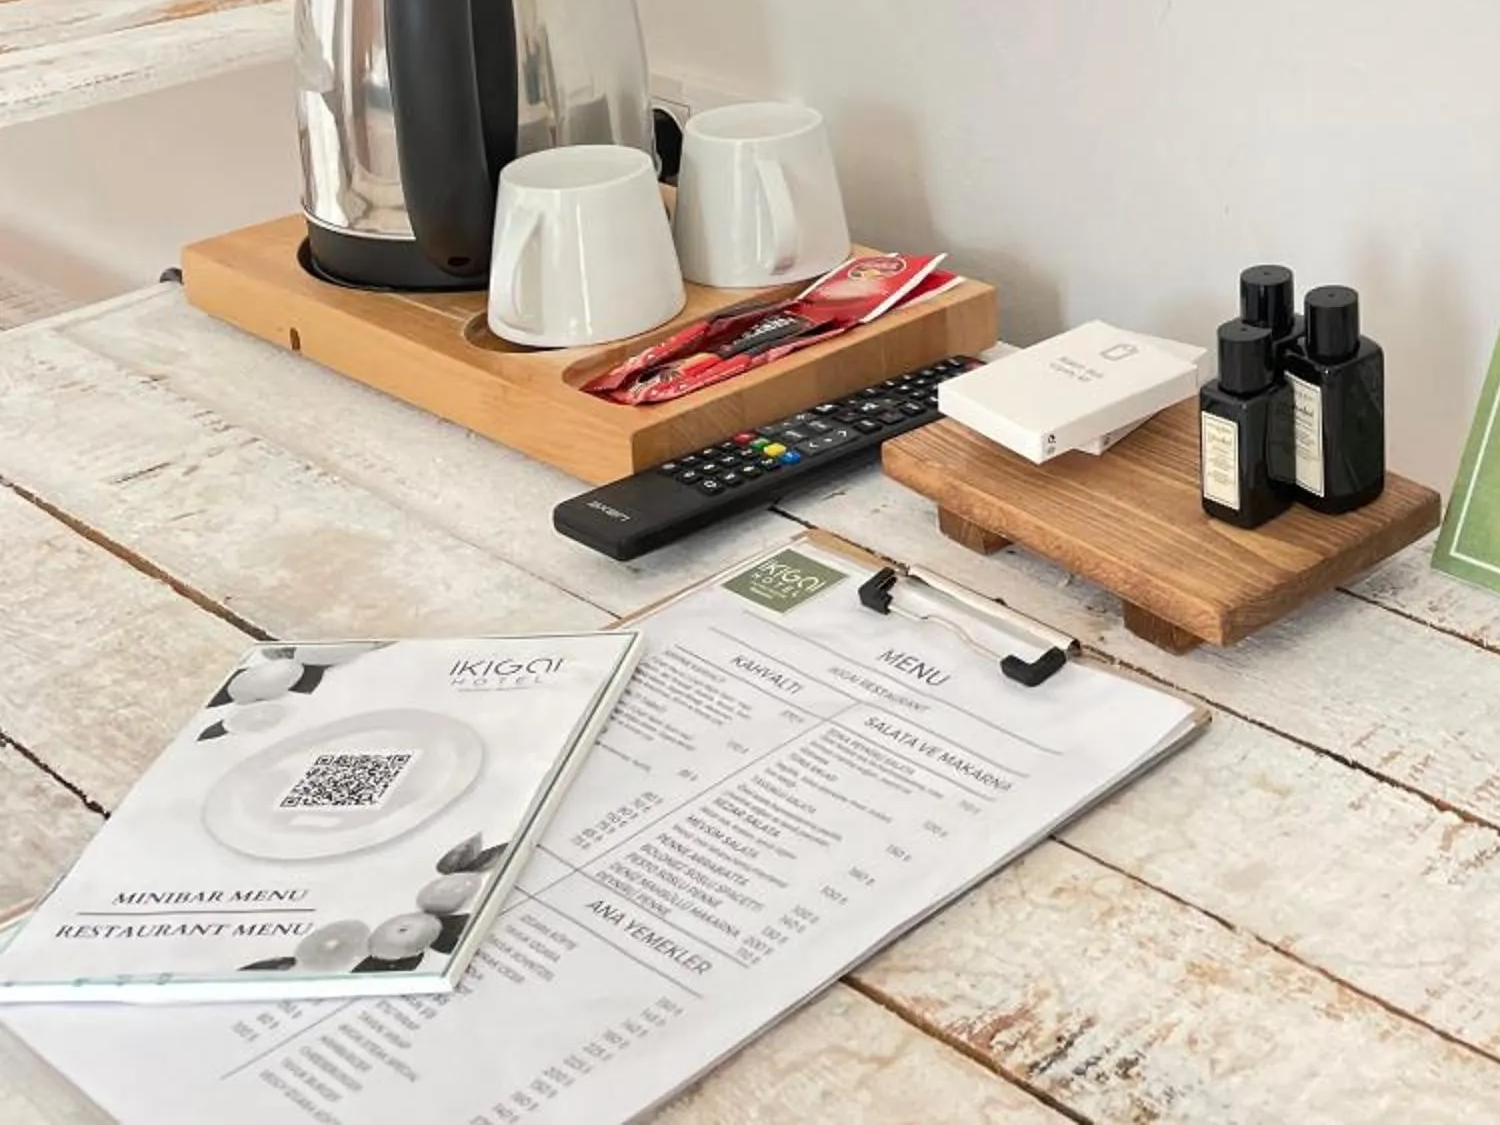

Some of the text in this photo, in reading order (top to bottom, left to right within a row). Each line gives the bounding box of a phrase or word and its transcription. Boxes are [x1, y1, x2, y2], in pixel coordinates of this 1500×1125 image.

[730, 654, 803, 694] KAHVALTI
[877, 649, 950, 686] MENU
[863, 716, 927, 749] SALATA
[917, 741, 942, 757] VE
[939, 751, 1011, 791] MAKARNA
[111, 889, 309, 906] MINIBAR MENU
[55, 922, 314, 939] RESTAURANT MENU
[585, 900, 626, 925] ANA
[623, 918, 712, 975] YEMEKLER
